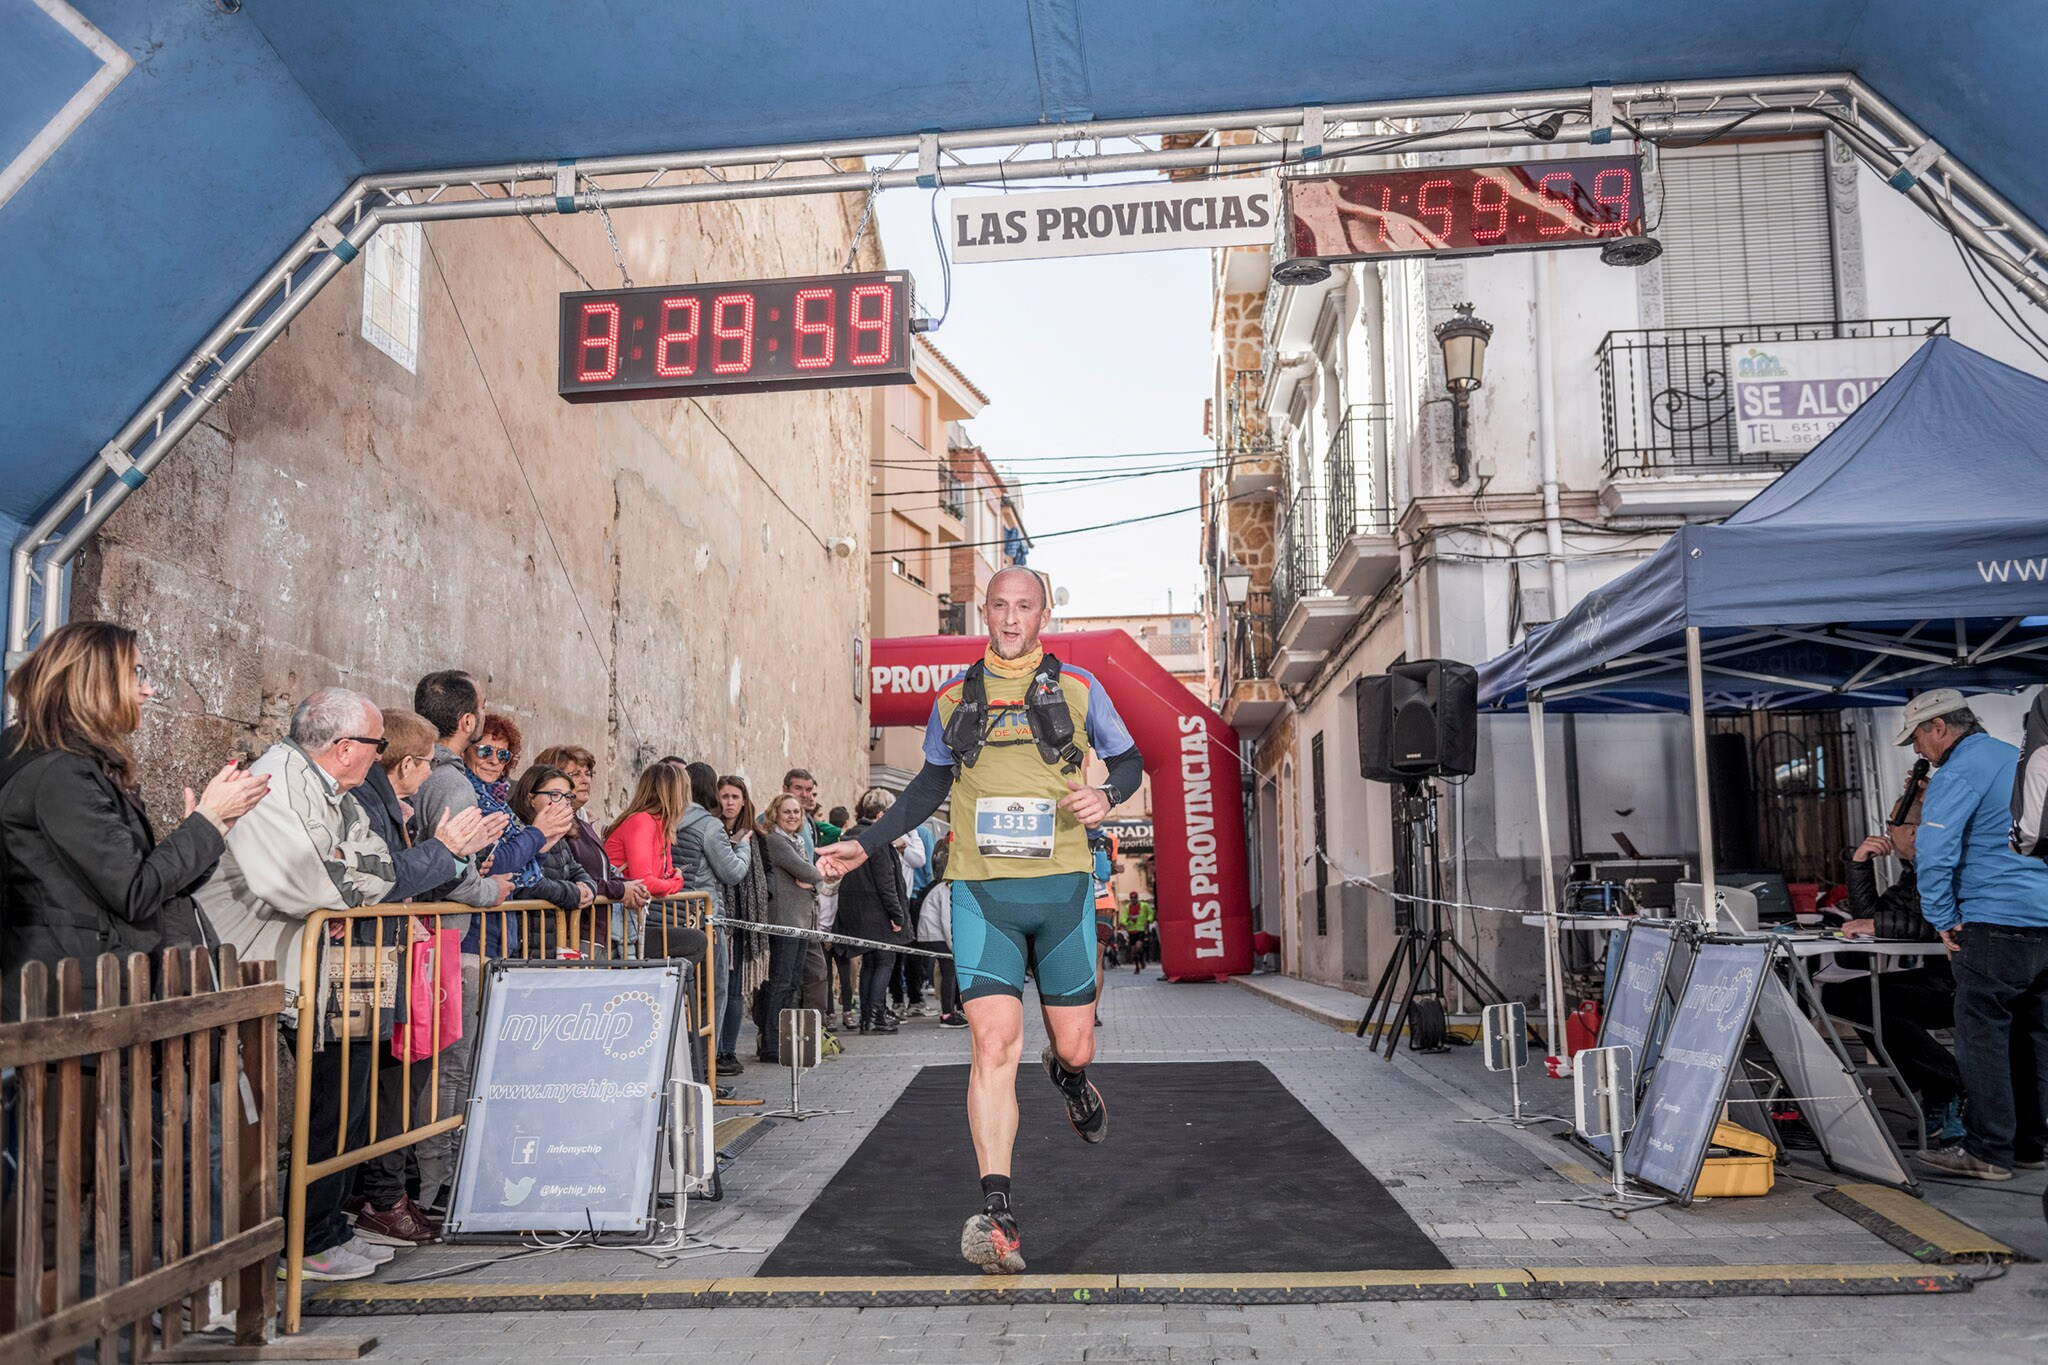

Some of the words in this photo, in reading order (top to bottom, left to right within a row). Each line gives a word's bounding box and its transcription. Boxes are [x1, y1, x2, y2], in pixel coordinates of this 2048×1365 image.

[957, 210, 1027, 247] LAS
[1036, 193, 1270, 241] PROVINCIAS
[1743, 384, 1782, 416] SE
[992, 814, 1038, 831] 1313
[1178, 715, 1219, 896] PROVINCIAS
[1192, 900, 1224, 958] LAS
[499, 1003, 634, 1050] mychip
[488, 1078, 648, 1103] www.mychip.es
[539, 1184, 607, 1196] @Mychip_Info
